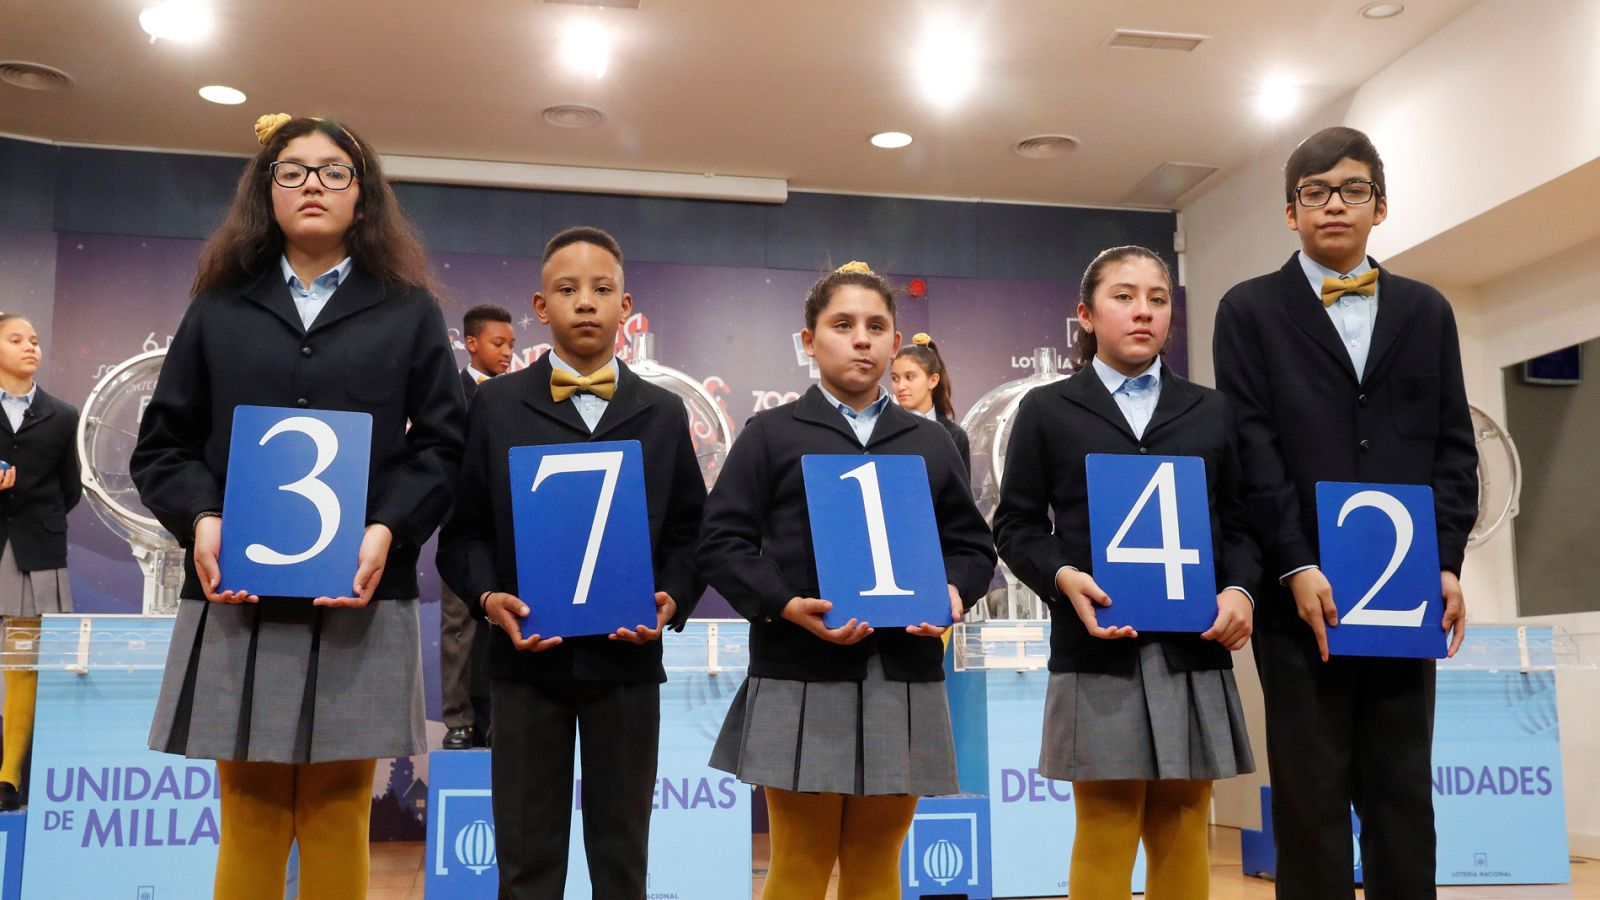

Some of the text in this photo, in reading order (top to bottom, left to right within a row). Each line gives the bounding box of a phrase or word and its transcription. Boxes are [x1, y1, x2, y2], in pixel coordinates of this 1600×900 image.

[245, 416, 340, 565] 3
[531, 451, 624, 605] 7
[839, 461, 915, 596] 1
[1106, 462, 1200, 600] 4
[1337, 490, 1428, 627] 2
[44, 810, 74, 831] DE
